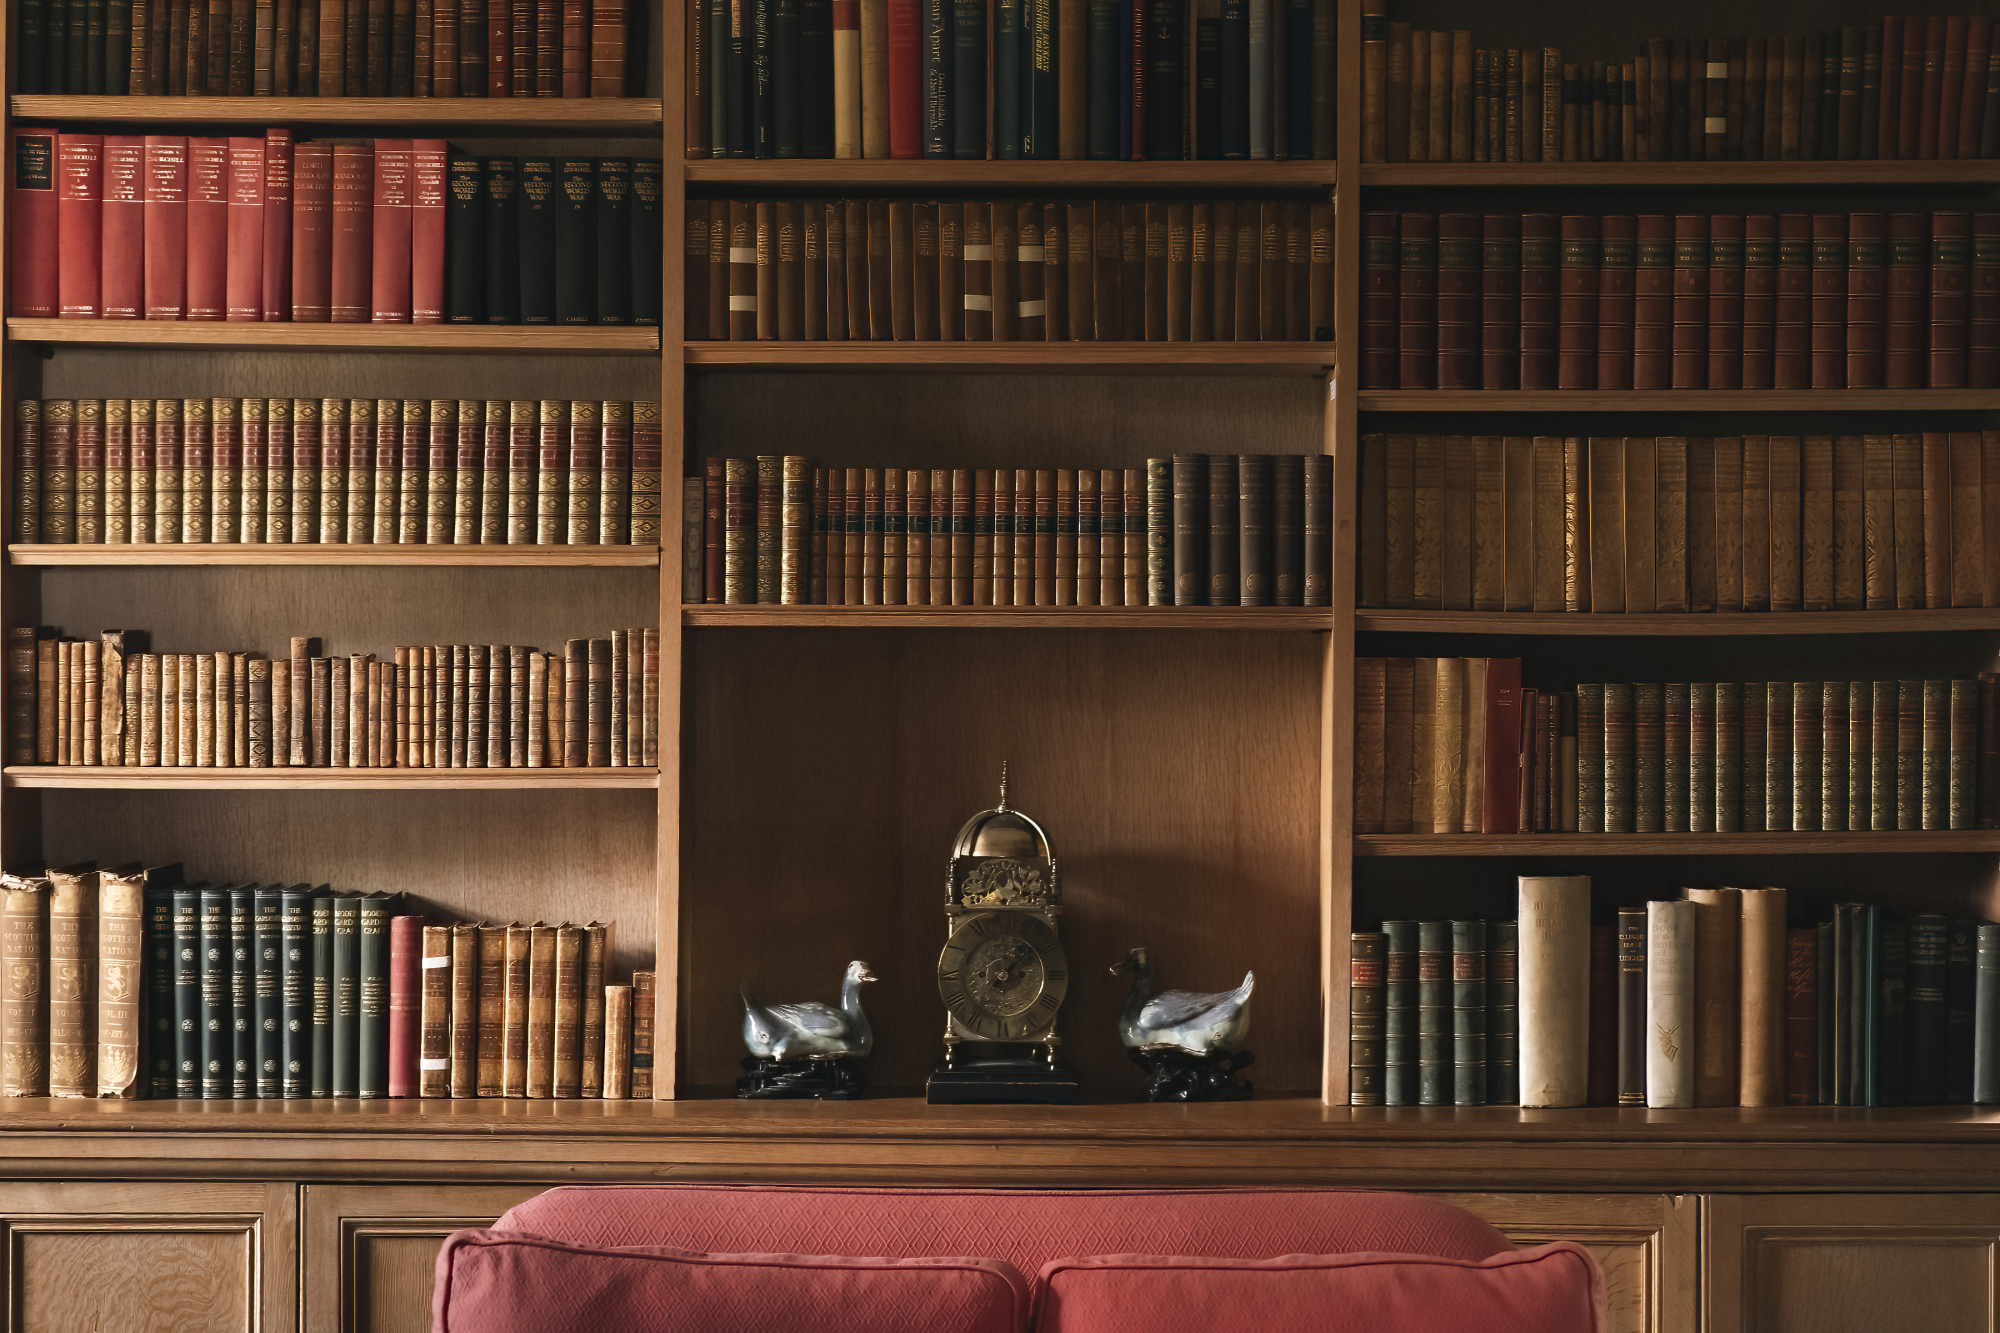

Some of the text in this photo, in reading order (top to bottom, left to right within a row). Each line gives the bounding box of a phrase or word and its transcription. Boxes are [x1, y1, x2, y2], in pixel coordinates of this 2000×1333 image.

[930, 24, 944, 62] Apart
[1534, 901, 1576, 910] HISTORY
[14, 922, 34, 930] THE
[108, 923, 126, 931] THE
[1536, 919, 1576, 928] BELVOIR
[1541, 930, 1571, 939] HUNT
[1789, 957, 1813, 968] Rod
